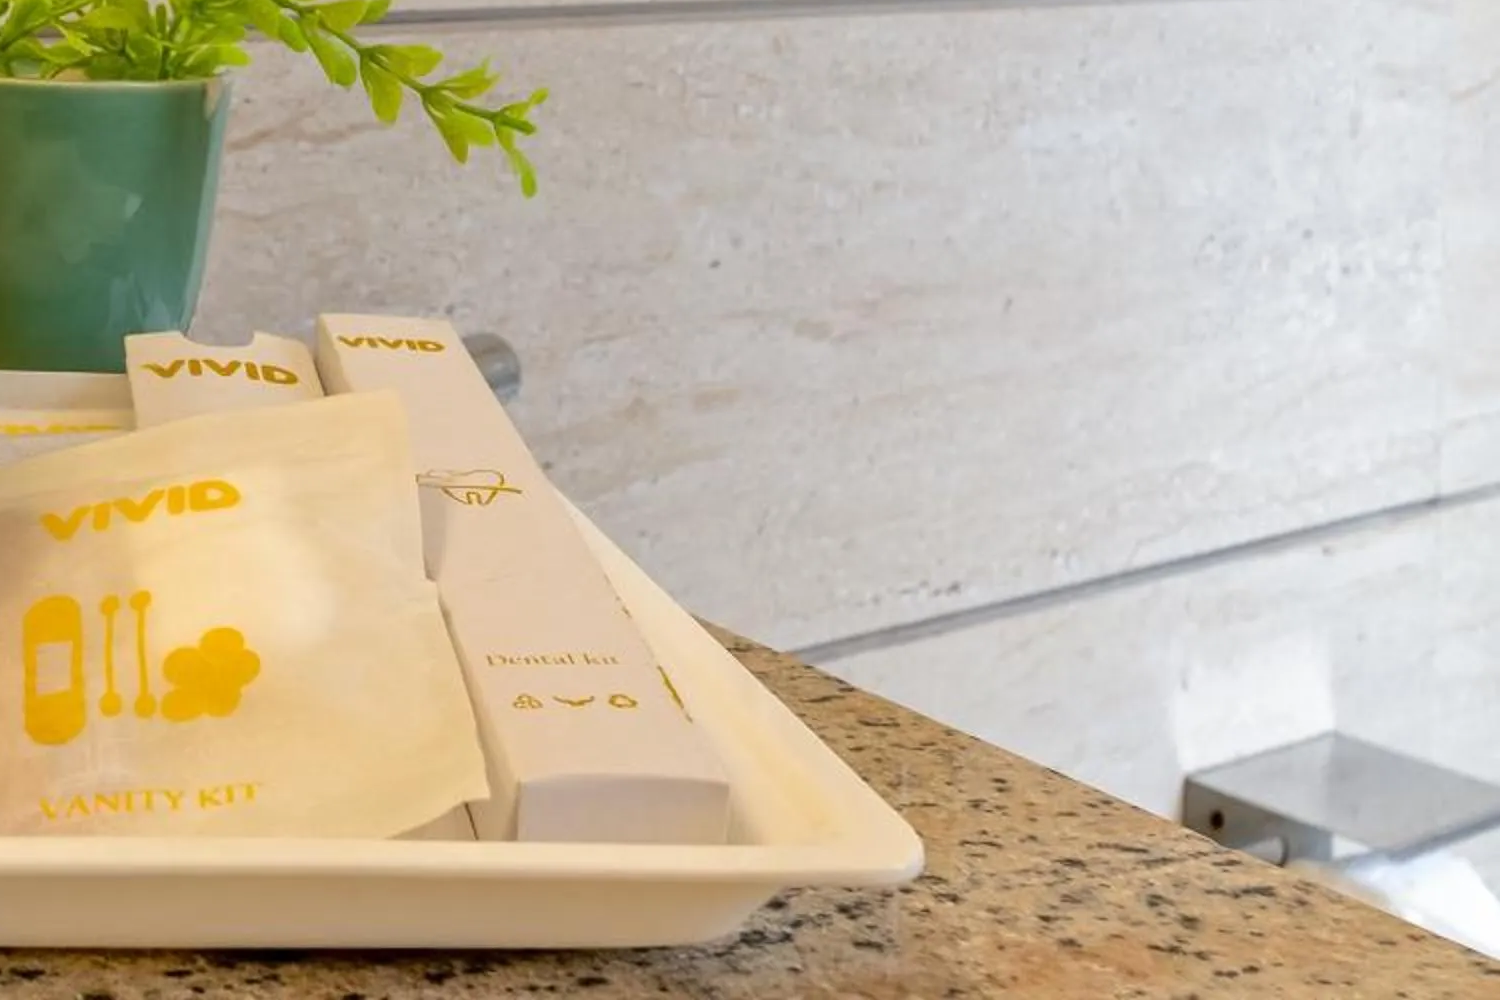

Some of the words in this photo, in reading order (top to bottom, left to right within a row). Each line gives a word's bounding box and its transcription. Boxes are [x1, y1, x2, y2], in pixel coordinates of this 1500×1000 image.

[337, 334, 446, 353] VIVID
[141, 358, 299, 386] VIVID
[41, 479, 242, 542] VIVID
[39, 789, 186, 822] VANITY
[197, 780, 263, 811] KIT
